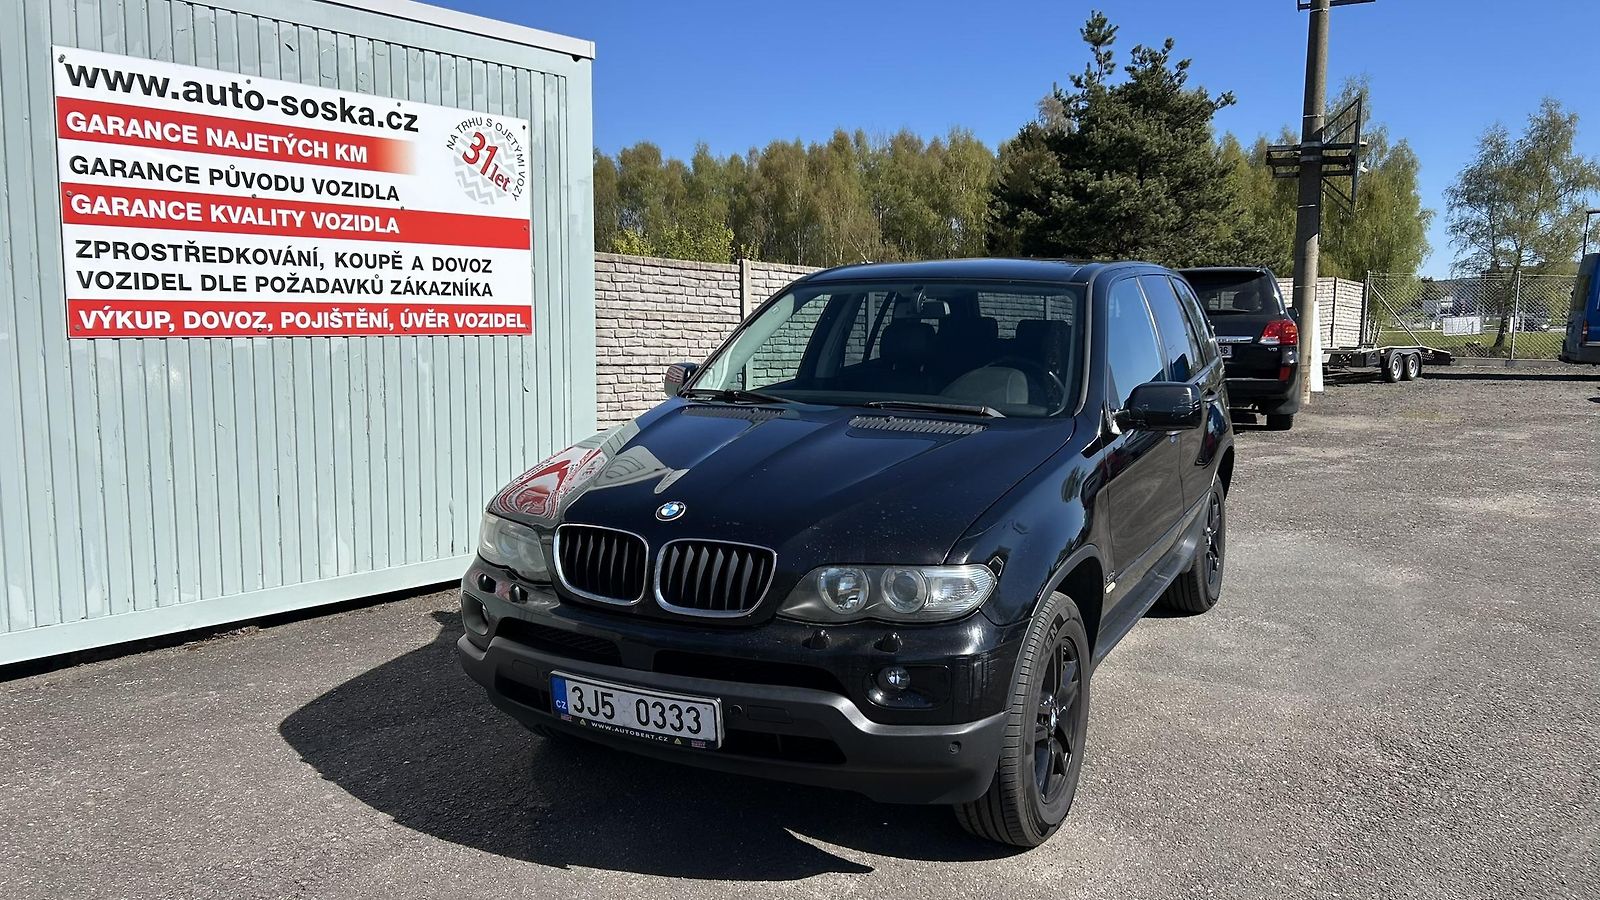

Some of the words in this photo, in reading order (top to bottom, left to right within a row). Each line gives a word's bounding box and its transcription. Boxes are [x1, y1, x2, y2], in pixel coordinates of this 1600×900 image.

[64, 63, 419, 132] www.auto-soska.cz
[66, 111, 198, 145] GARANCE
[206, 128, 328, 160] NAJETÝCH
[335, 143, 368, 163] KM
[69, 155, 200, 184] GARANCE
[208, 164, 305, 193] PŮVODU
[312, 178, 400, 201] VOZIDLA
[446, 133, 459, 151] NA
[455, 117, 483, 134] TRHU
[485, 118, 493, 128] S
[512, 171, 526, 201] VOZY
[462, 131, 498, 176] 31
[487, 163, 511, 192] let
[70, 194, 202, 221] GARANCE
[210, 205, 306, 228] KVALITY
[311, 211, 400, 234] VOZIDLA
[75, 239, 325, 270] ZPROSTŘEDKOVÁNÍ,
[334, 251, 403, 270] KOUPĚ
[411, 255, 424, 271] A
[432, 256, 493, 273] DOVOZ
[76, 270, 192, 291] VOZIDEL
[200, 274, 247, 292] DLE
[255, 272, 384, 295] POŽADAVKŮ
[390, 276, 493, 297] ZÁKAZNÍKA
[79, 305, 175, 333] VÝKUP,
[183, 311, 273, 332] DOVOZ,
[280, 308, 394, 332] POJIŠTĚNÍ,
[400, 308, 449, 328] ÚVĚR
[454, 312, 525, 329] VOZIDEL
[555, 699, 567, 710] CZ
[571, 686, 616, 720] 3J5
[635, 698, 702, 735] 0333
[591, 721, 668, 742] WWW.AUTOBERT.CZ
